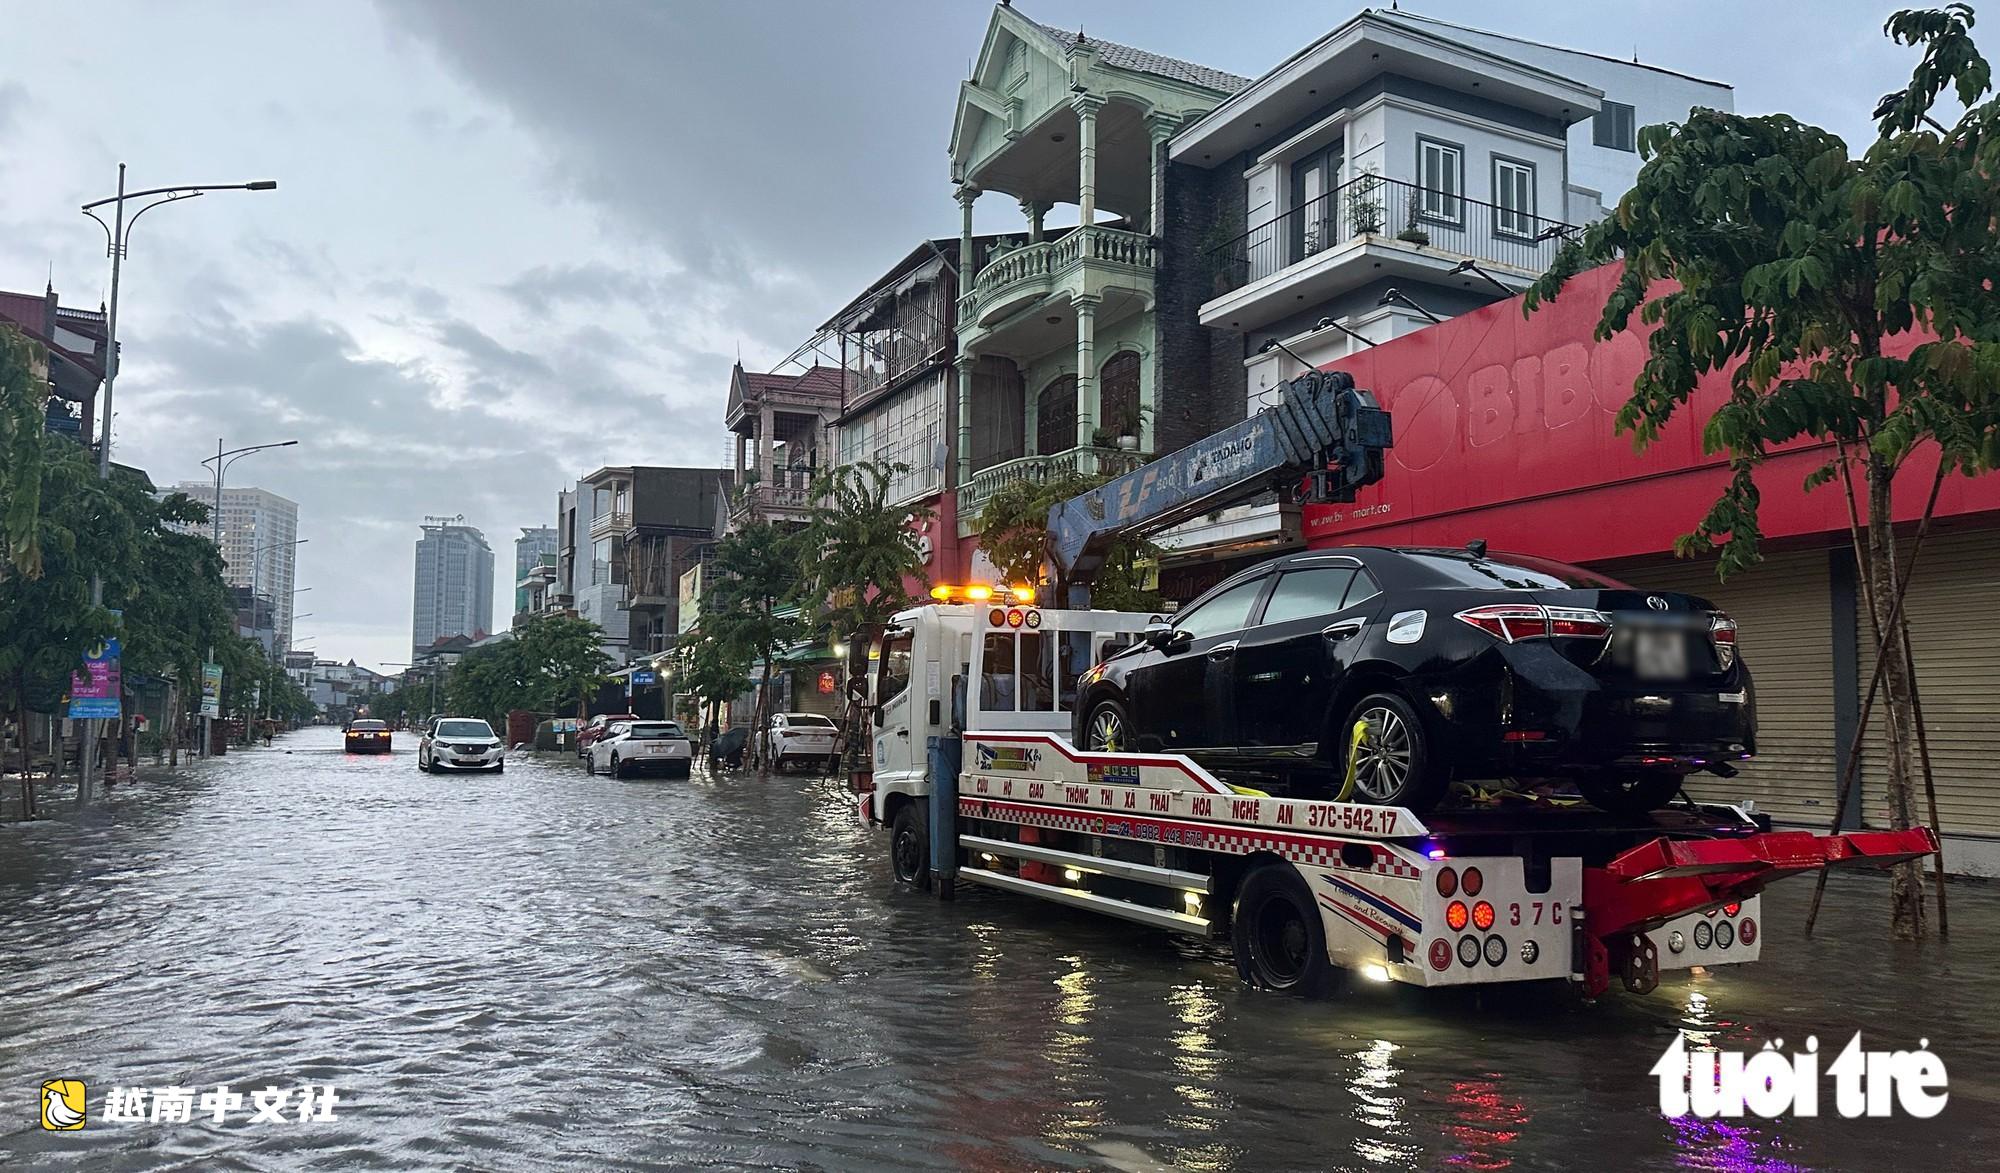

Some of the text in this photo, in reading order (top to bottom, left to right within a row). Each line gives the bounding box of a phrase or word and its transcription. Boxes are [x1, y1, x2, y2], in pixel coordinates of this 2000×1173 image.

[1003, 779, 1012, 798] HỘ
[1029, 783, 1044, 799] GIAO
[1066, 785, 1089, 804] THÔNG
[1100, 789, 1113, 808] THỊ
[1232, 799, 1260, 824] NGHỆ
[1276, 804, 1294, 825] AN
[1308, 804, 1398, 835] 37C-542.17
[1135, 823, 1160, 841] 0982
[1353, 904, 1369, 916] and
